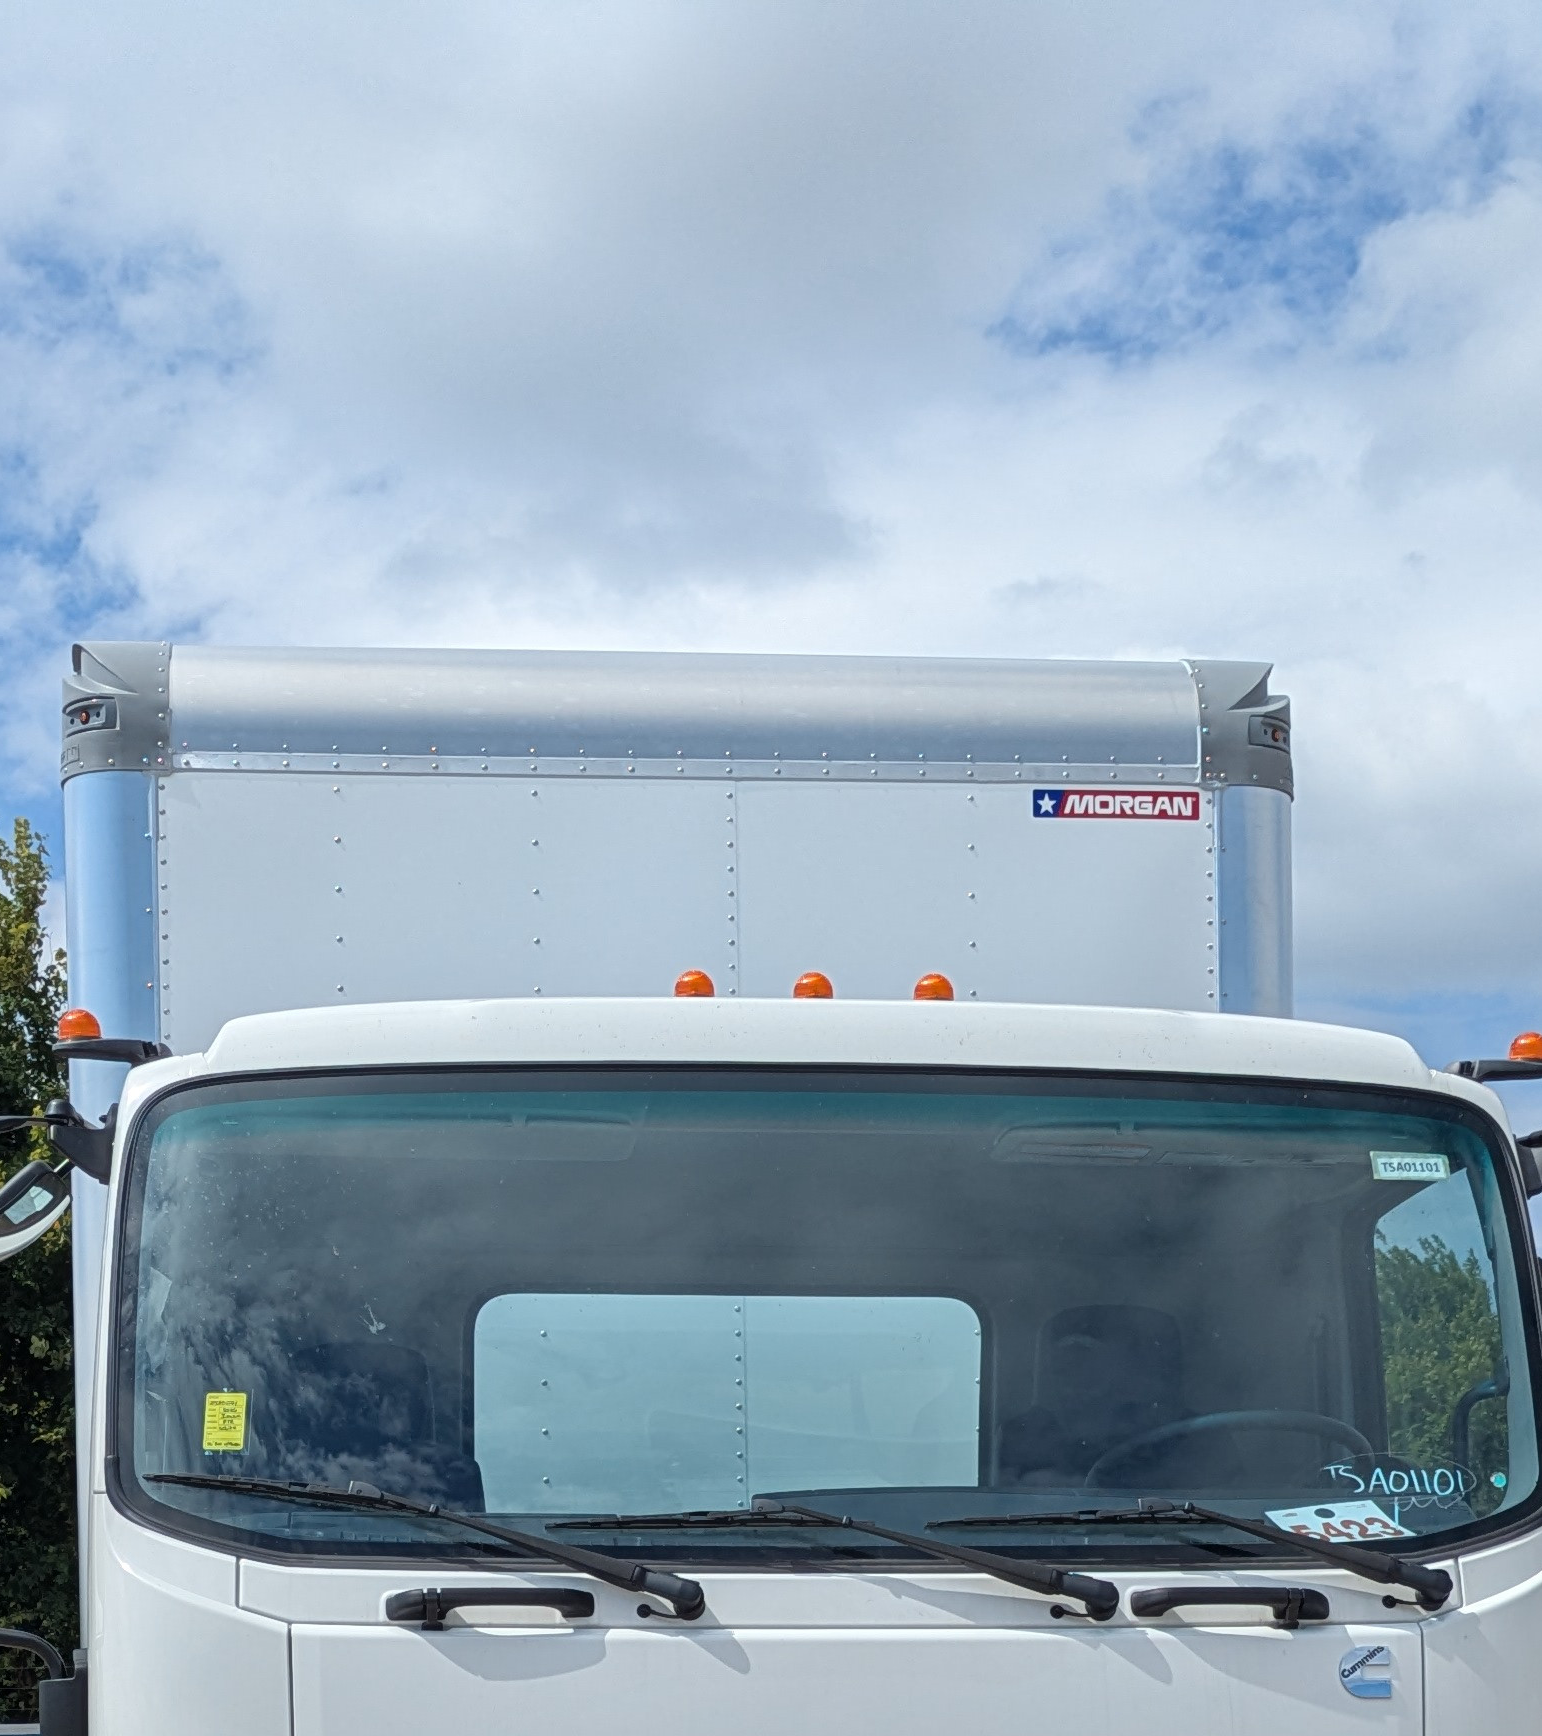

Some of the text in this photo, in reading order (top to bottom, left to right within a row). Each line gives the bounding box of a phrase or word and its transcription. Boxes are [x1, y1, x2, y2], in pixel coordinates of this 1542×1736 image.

[1064, 794, 1193, 816] MORGAN
[1380, 1161, 1441, 1173] TSA01101
[1288, 1516, 1405, 1542] 5423
[1340, 1645, 1385, 1679] Cummins
